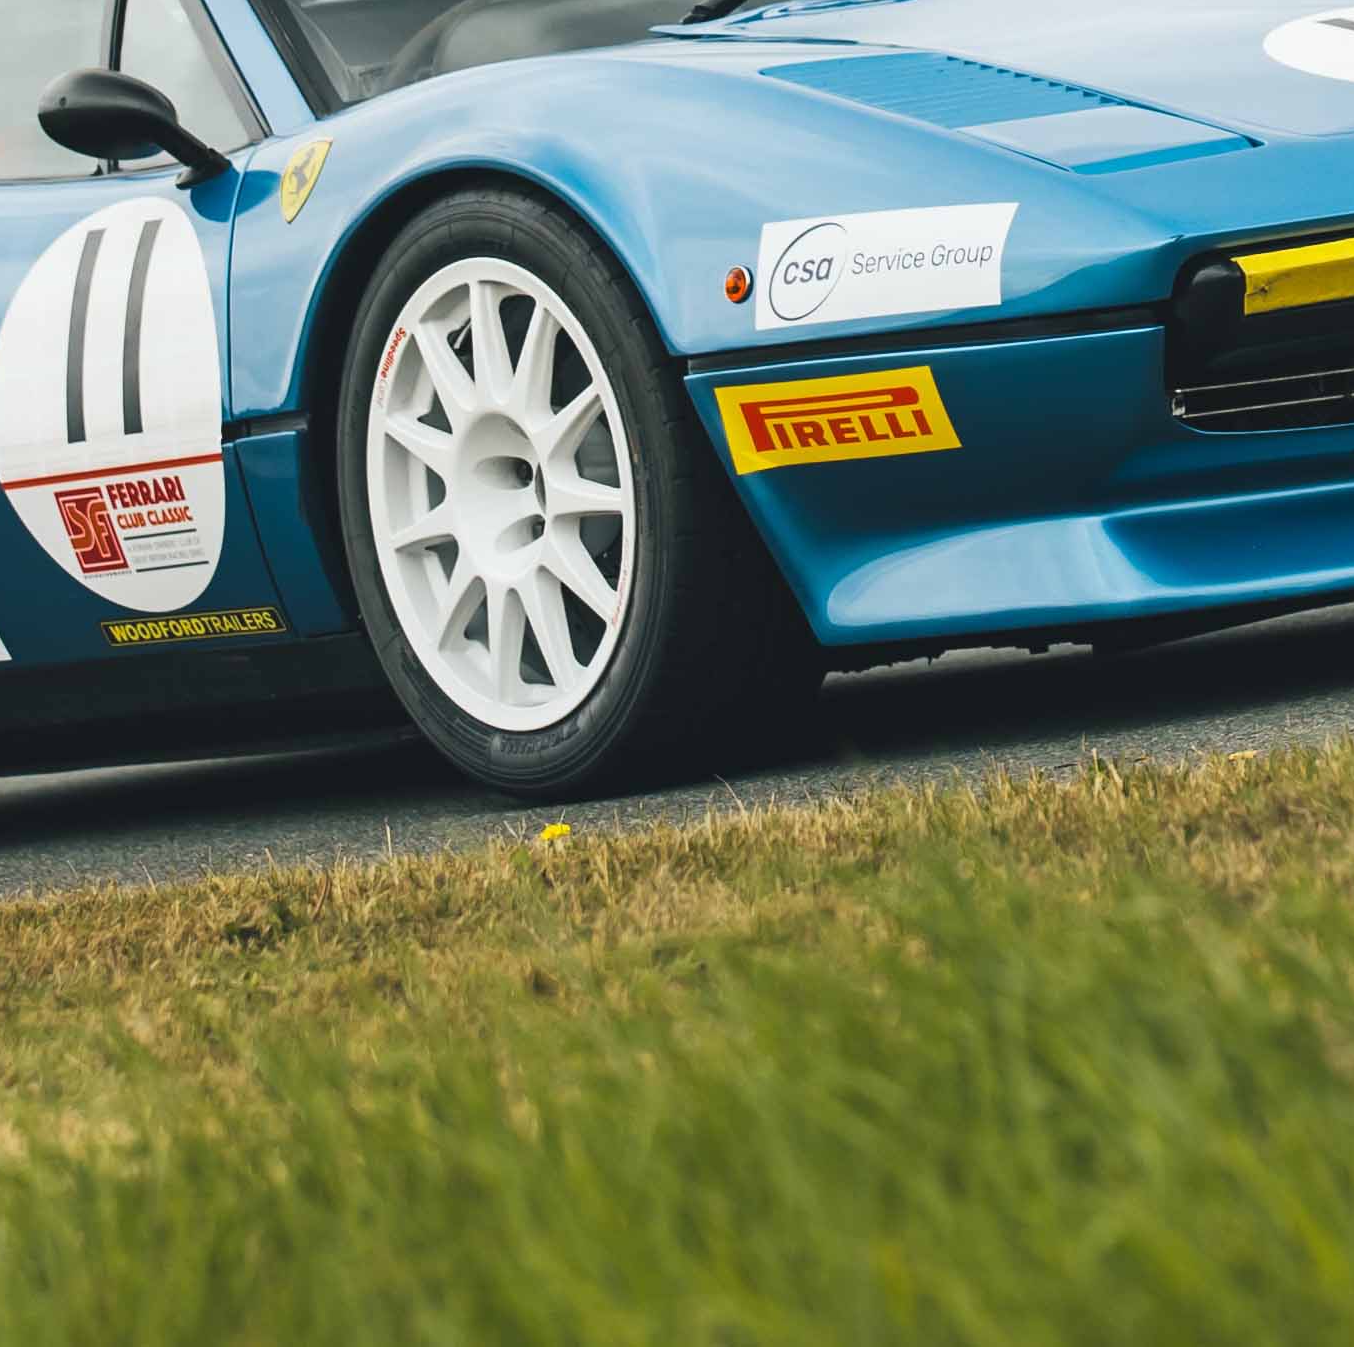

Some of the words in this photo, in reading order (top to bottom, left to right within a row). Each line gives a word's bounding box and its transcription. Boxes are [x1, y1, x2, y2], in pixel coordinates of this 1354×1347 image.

[783, 256, 834, 286] csa
[851, 248, 925, 275] Service
[931, 244, 993, 267] Group
[66, 218, 164, 445] 11
[739, 386, 933, 453] PIRELLI
[105, 475, 186, 510] FERRARI
[116, 511, 146, 530] CLUB
[147, 505, 194, 526] CLASSIC
